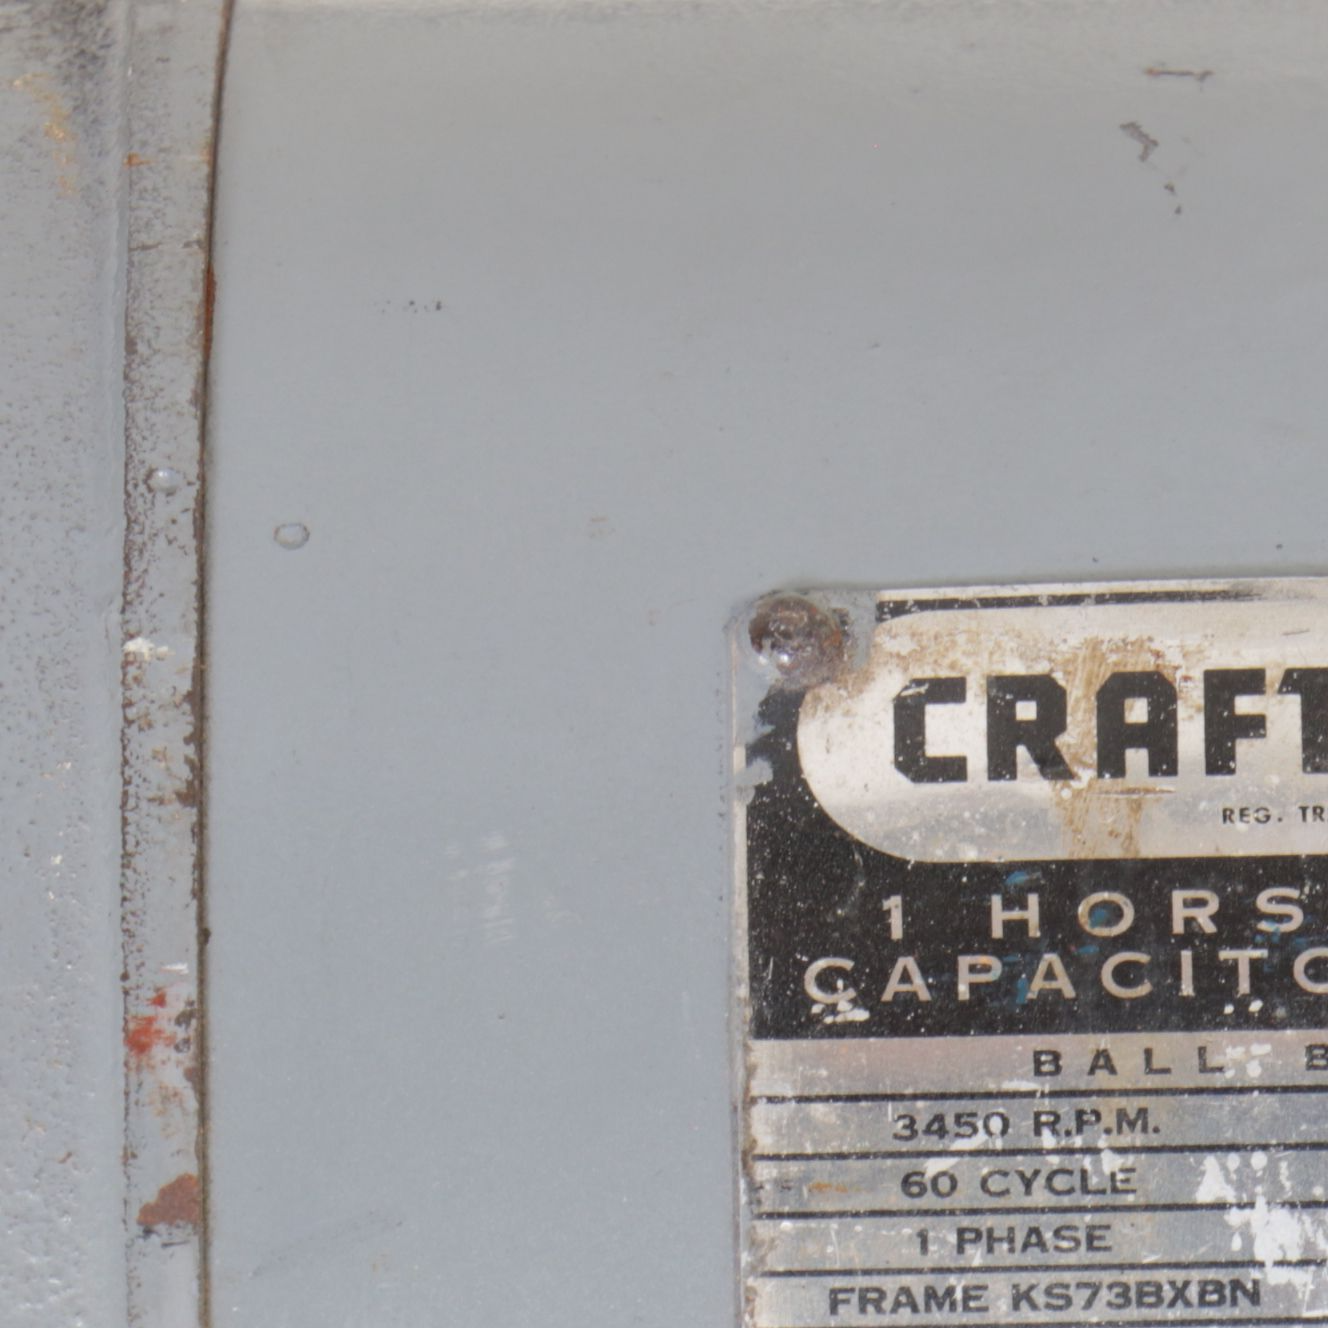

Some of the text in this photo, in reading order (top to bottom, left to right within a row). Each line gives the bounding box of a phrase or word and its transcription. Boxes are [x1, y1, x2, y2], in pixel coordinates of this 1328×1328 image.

[1223, 806, 1284, 824] REG.
[882, 895, 903, 940] 1
[1033, 1046, 1224, 1077] BALL
[892, 1107, 1160, 1141] 3450 R.P.M.
[901, 1168, 1137, 1198] 60 CYCLE
[917, 1224, 1113, 1255] 1 PHASE
[829, 1279, 1261, 1316] FRAME KS73BXBN
